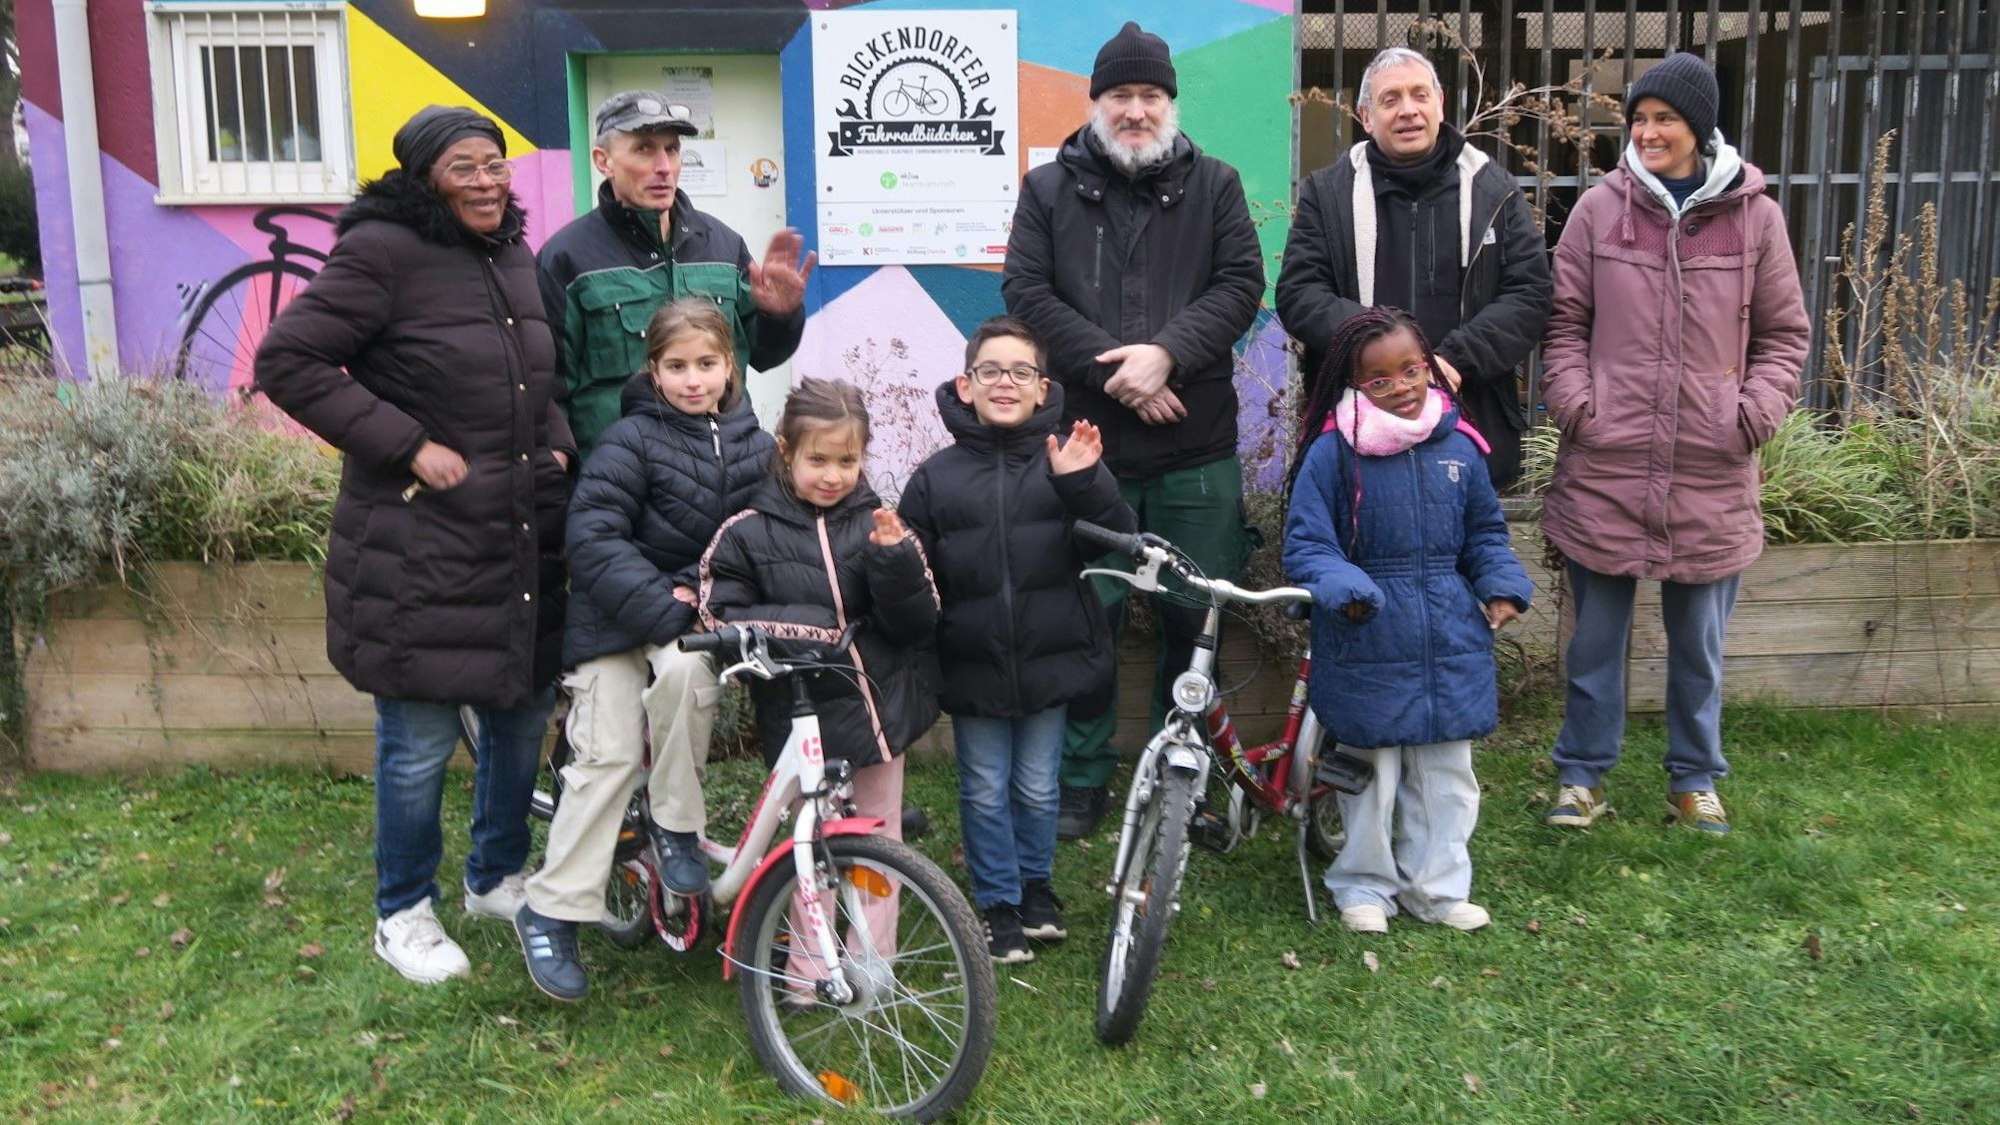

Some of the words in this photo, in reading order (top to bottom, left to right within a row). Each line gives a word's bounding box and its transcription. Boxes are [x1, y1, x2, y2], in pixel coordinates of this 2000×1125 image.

[840, 27, 990, 90] BICKENDORFER
[856, 124, 977, 144] Fahrradbüdchen
[872, 207, 914, 215] Unterstützer
[929, 207, 965, 216] Sponsoren
